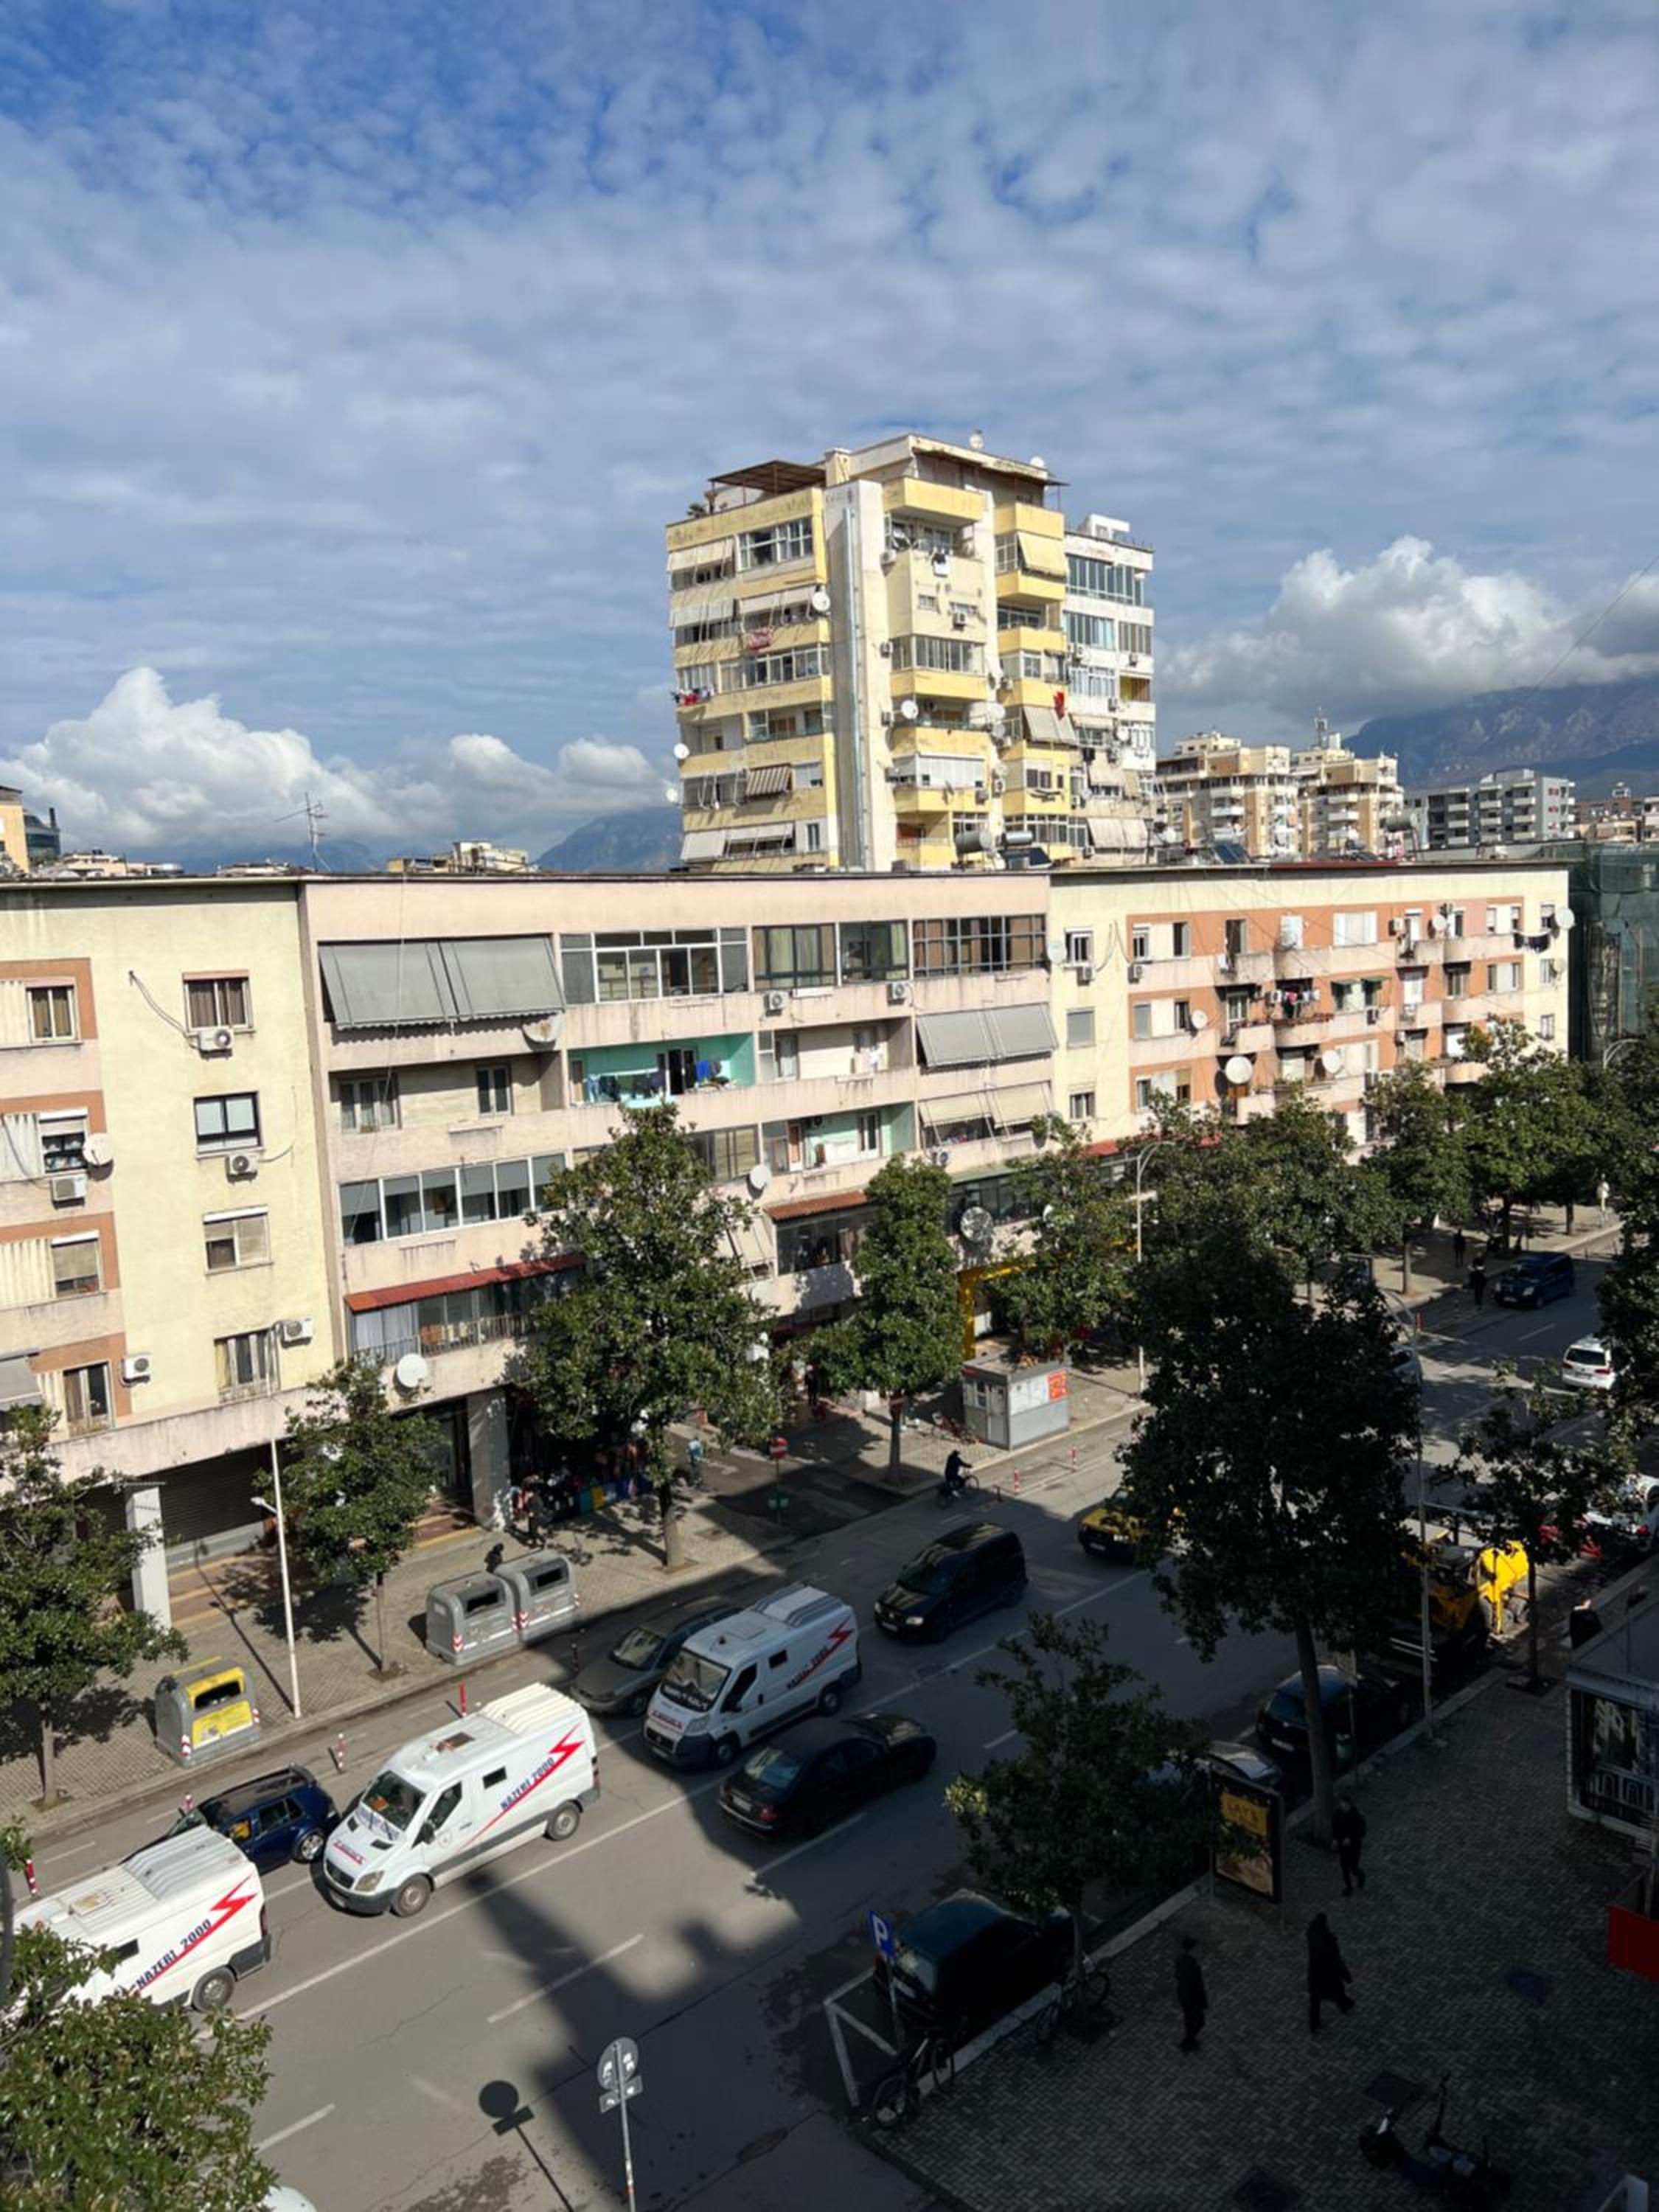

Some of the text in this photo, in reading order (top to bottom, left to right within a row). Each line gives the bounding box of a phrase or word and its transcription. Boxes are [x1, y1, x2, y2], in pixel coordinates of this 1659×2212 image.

[532, 1757, 555, 1781] 2000
[872, 1914, 888, 1947] P
[136, 1919, 212, 1990] NAZERI 2000
